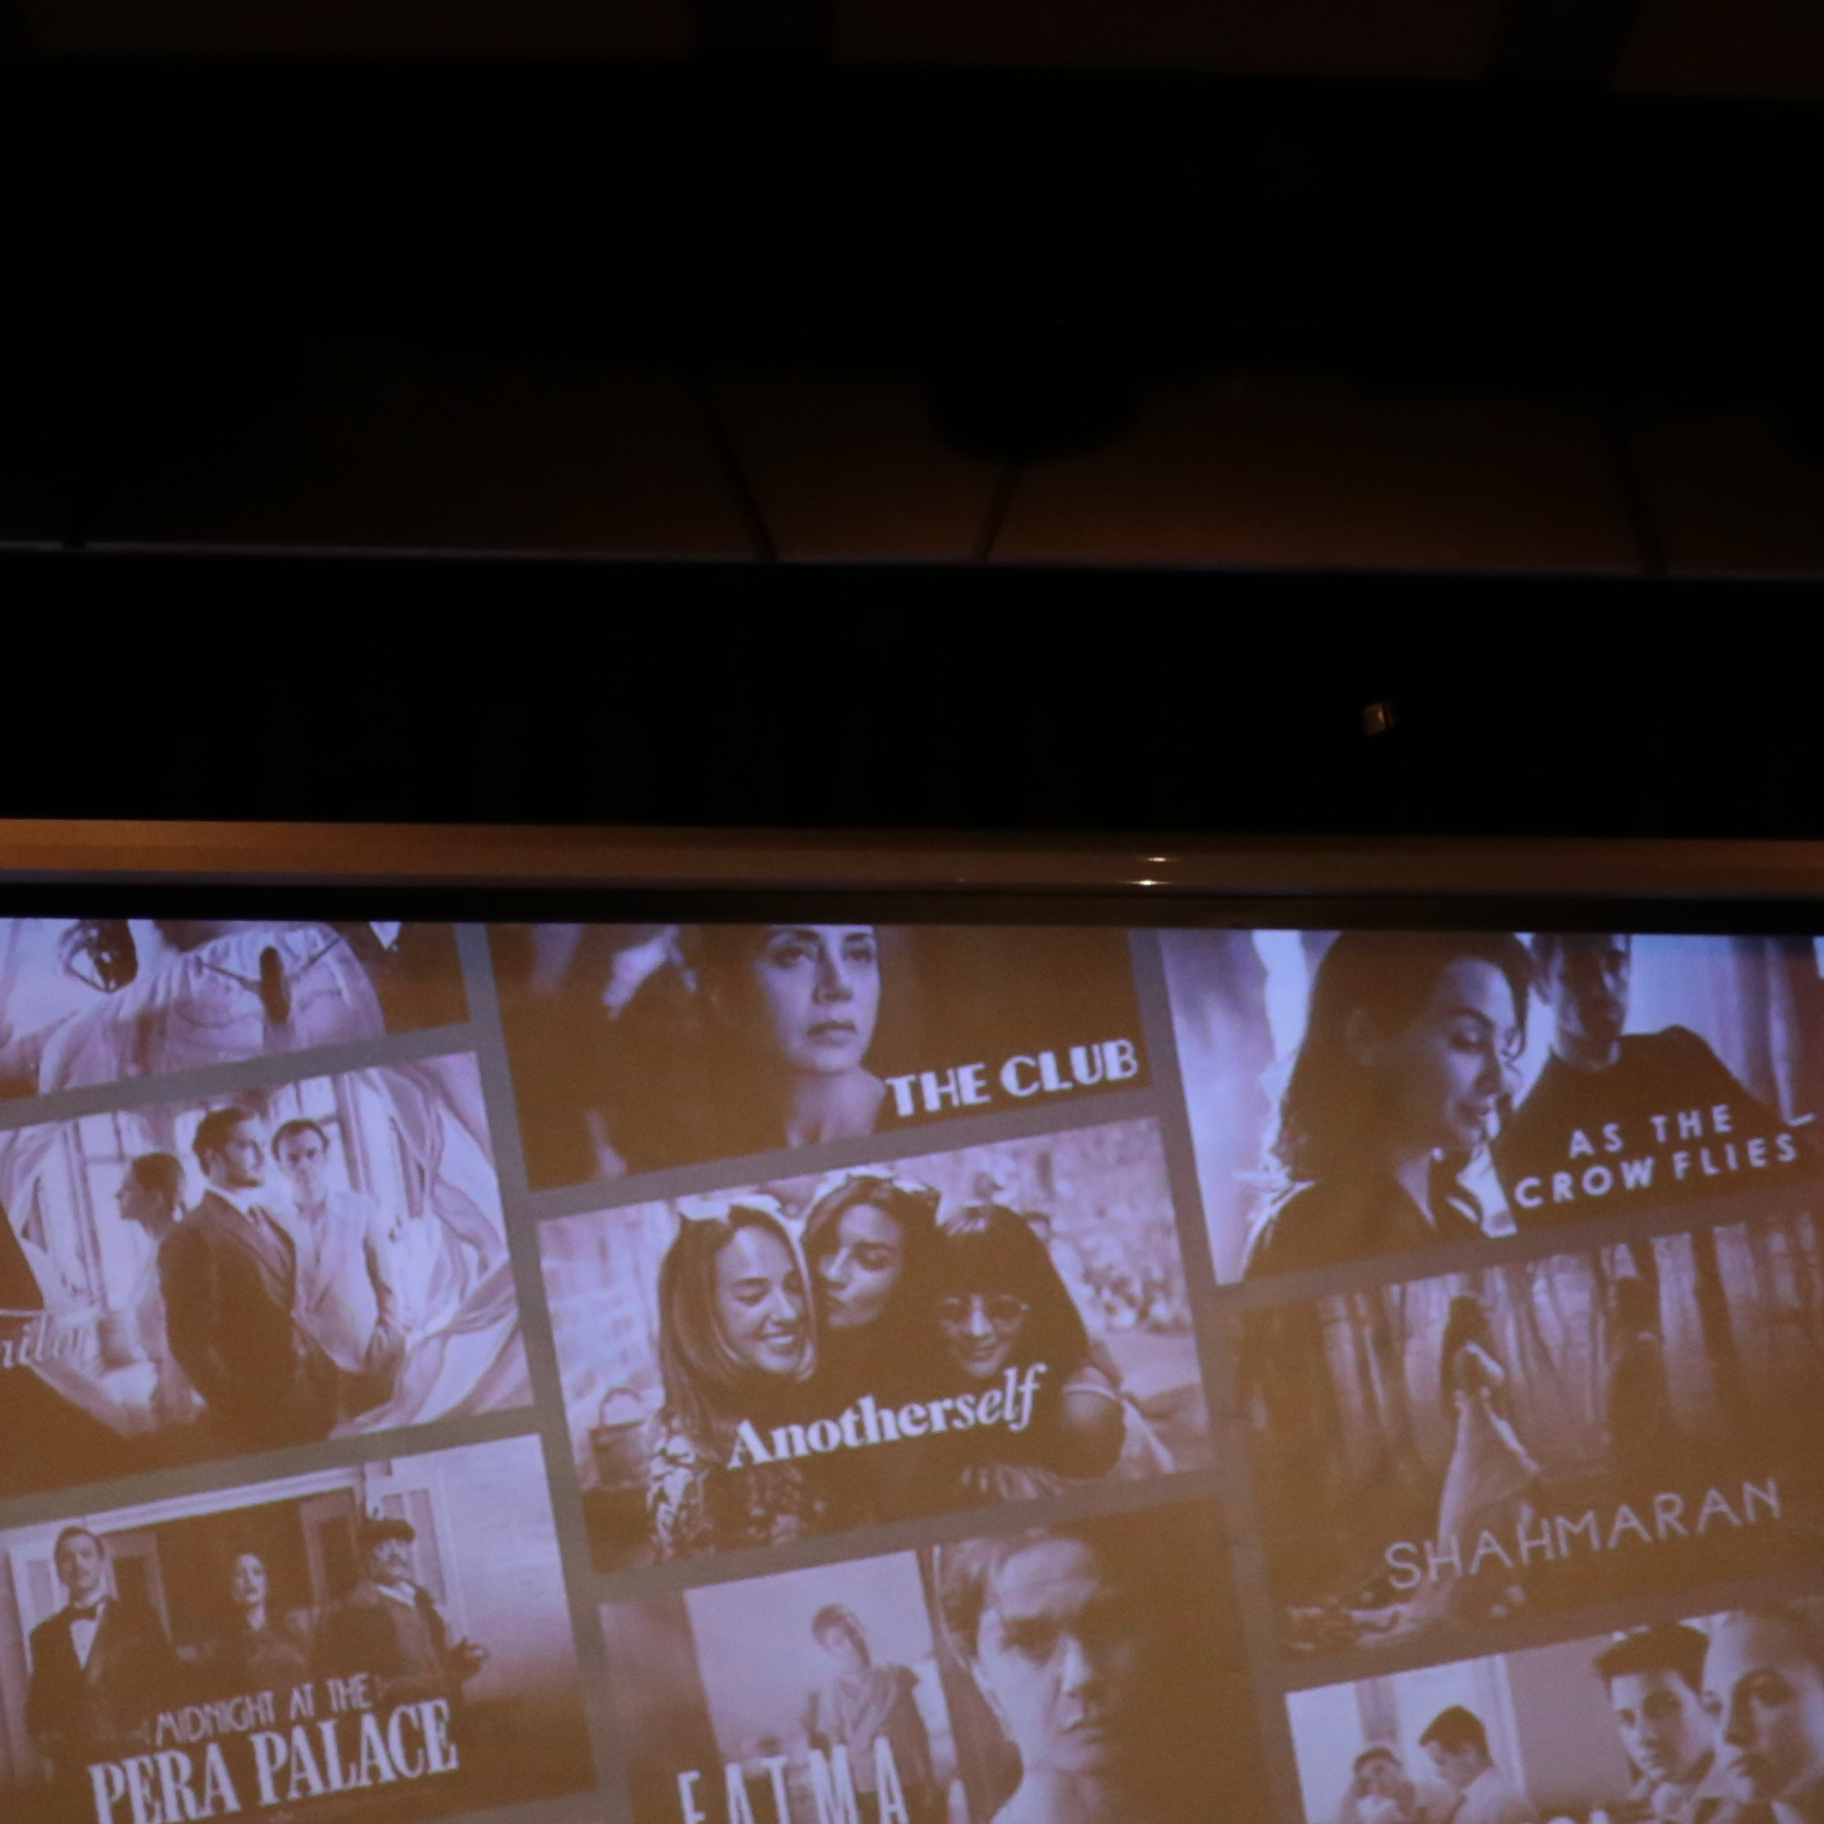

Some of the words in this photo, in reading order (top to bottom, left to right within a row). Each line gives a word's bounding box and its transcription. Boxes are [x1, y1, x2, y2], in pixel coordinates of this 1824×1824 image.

[885, 1062, 991, 1117] THE
[1000, 1038, 1139, 1099] CLUB
[1514, 1156, 1656, 1208] CROW
[1672, 1132, 1798, 1182] FLIES
[1568, 1122, 1624, 1159] AS
[1650, 1104, 1734, 1143] THE
[1384, 1477, 1783, 1590] SHAHMARAN
[326, 1671, 374, 1713] THE
[248, 1698, 460, 1806] PALACE
